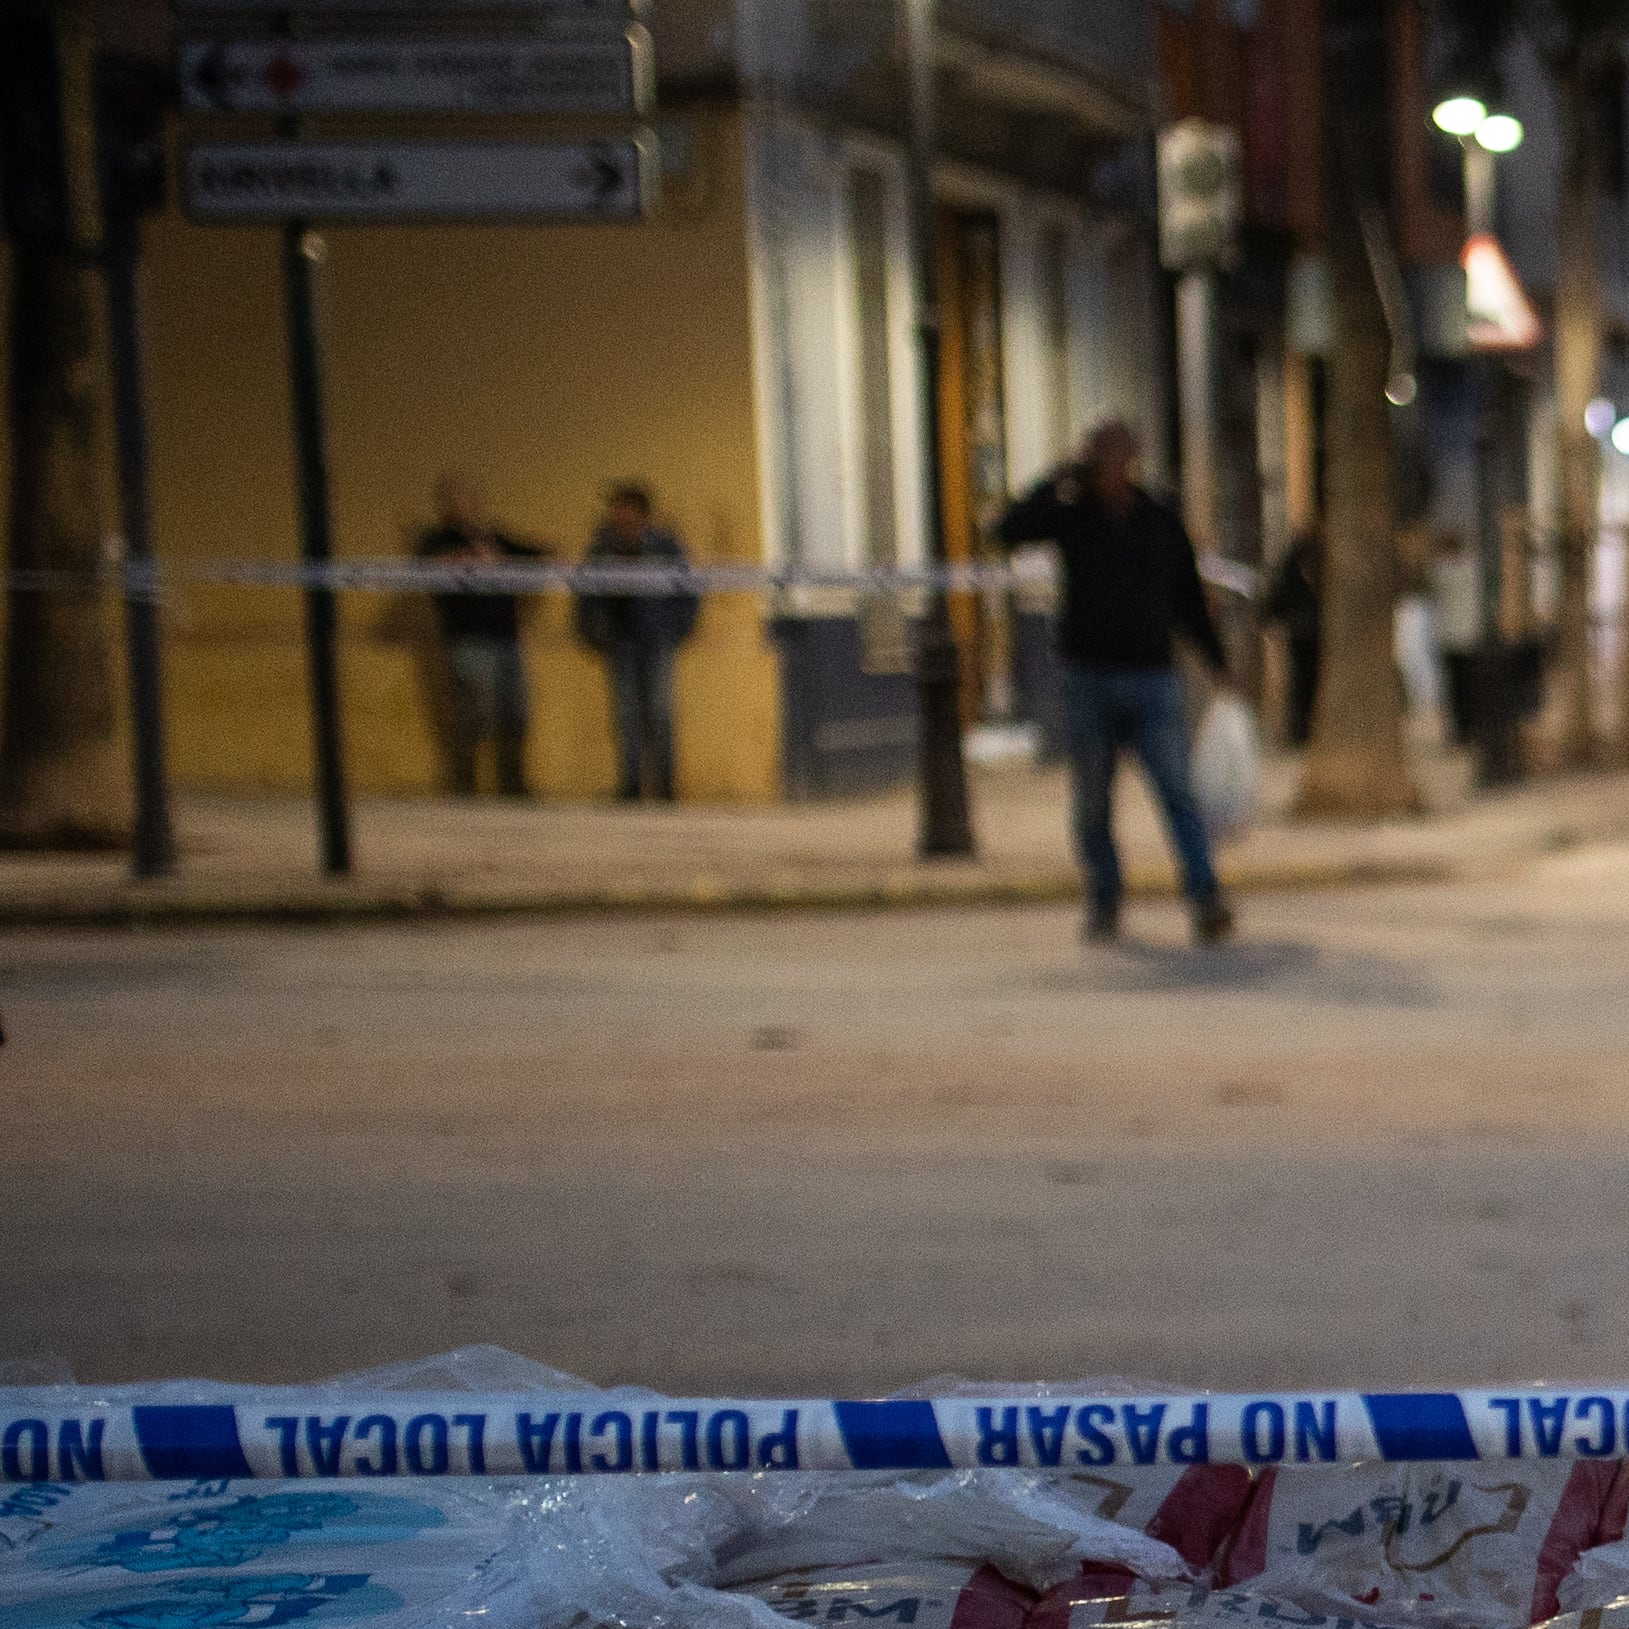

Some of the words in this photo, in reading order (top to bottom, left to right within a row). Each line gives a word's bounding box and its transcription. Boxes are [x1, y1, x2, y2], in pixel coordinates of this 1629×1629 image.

[2, 1417, 105, 1479] NO
[266, 1413, 487, 1476] LOCAL
[516, 1408, 801, 1474] POLICIA
[976, 1402, 1208, 1468] PASAR
[1242, 1398, 1338, 1463] NO
[770, 1597, 919, 1625] BM
